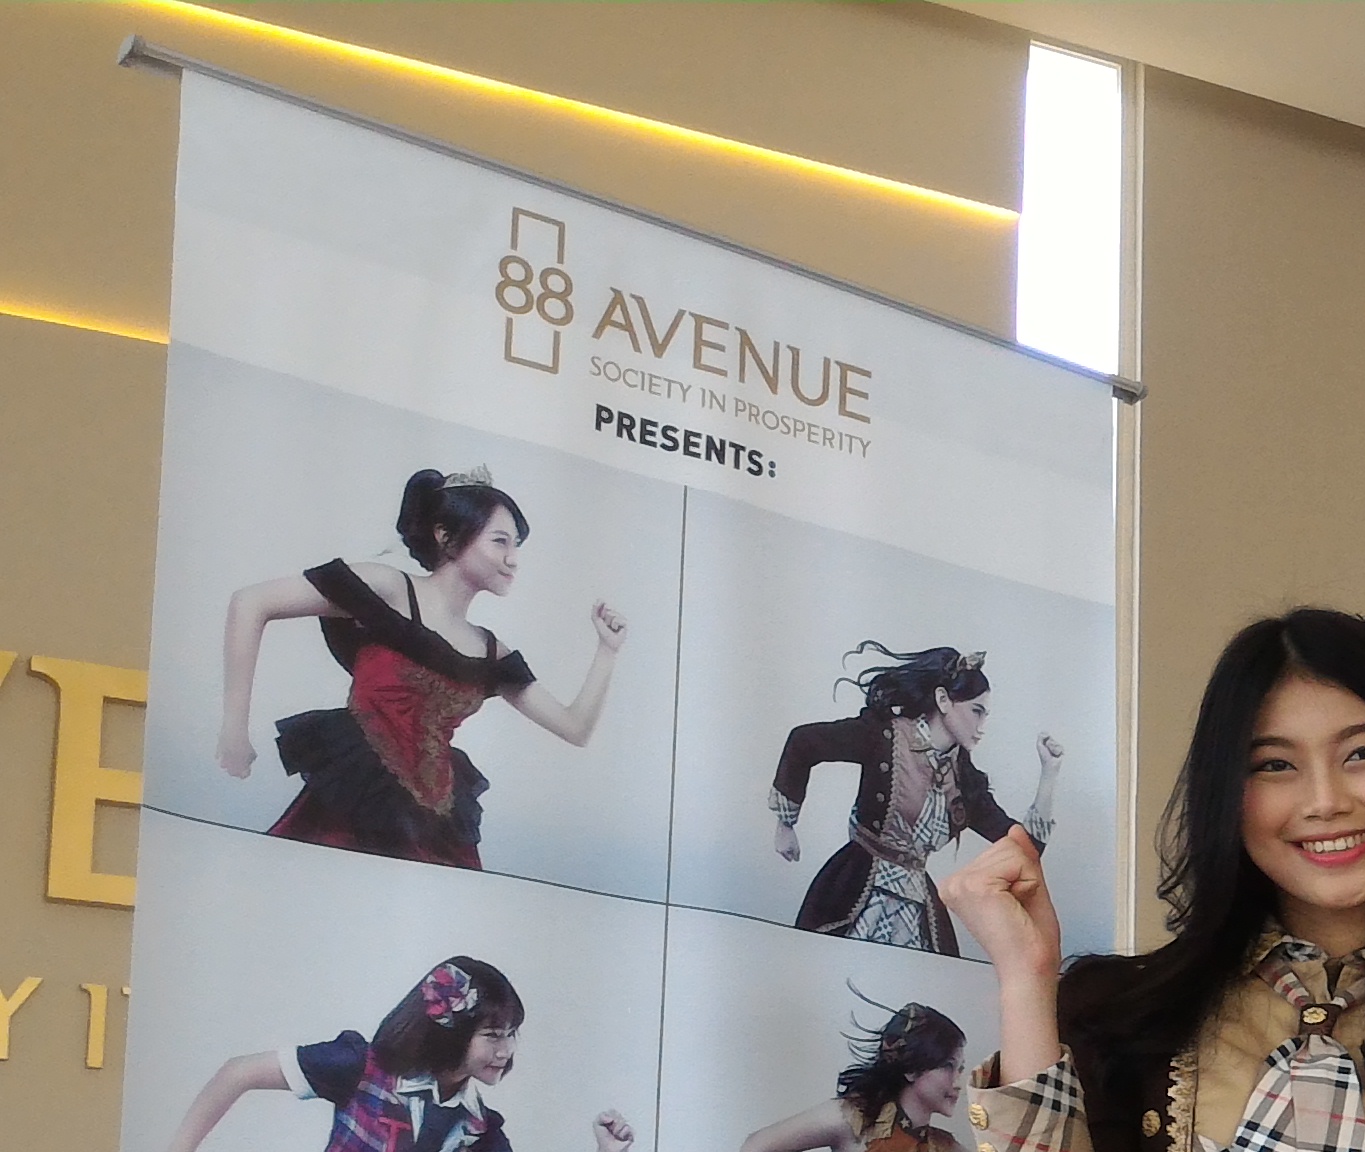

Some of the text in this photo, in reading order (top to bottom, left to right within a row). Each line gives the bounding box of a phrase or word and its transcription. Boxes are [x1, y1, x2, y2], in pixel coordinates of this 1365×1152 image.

[495, 255, 872, 424] 88 AVENUE
[589, 356, 871, 458] SOCIETY IN PROSPERITY
[594, 403, 776, 478] PRESENTS:
[0, 651, 149, 907] E
